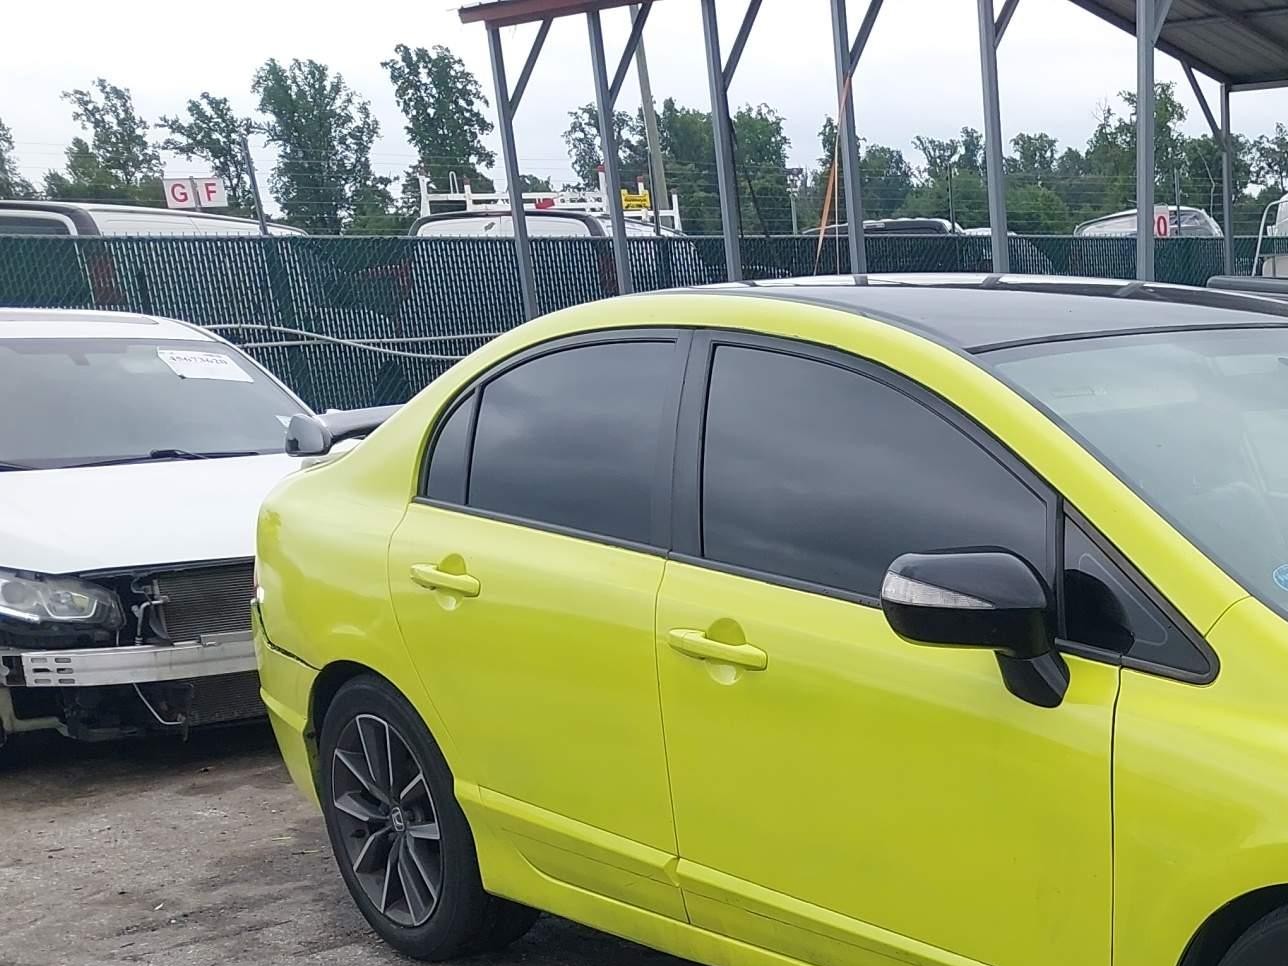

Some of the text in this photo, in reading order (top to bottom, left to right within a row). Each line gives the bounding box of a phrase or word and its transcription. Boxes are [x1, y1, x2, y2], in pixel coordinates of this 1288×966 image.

[171, 183, 217, 203] G F
[1154, 215, 1168, 236] 0
